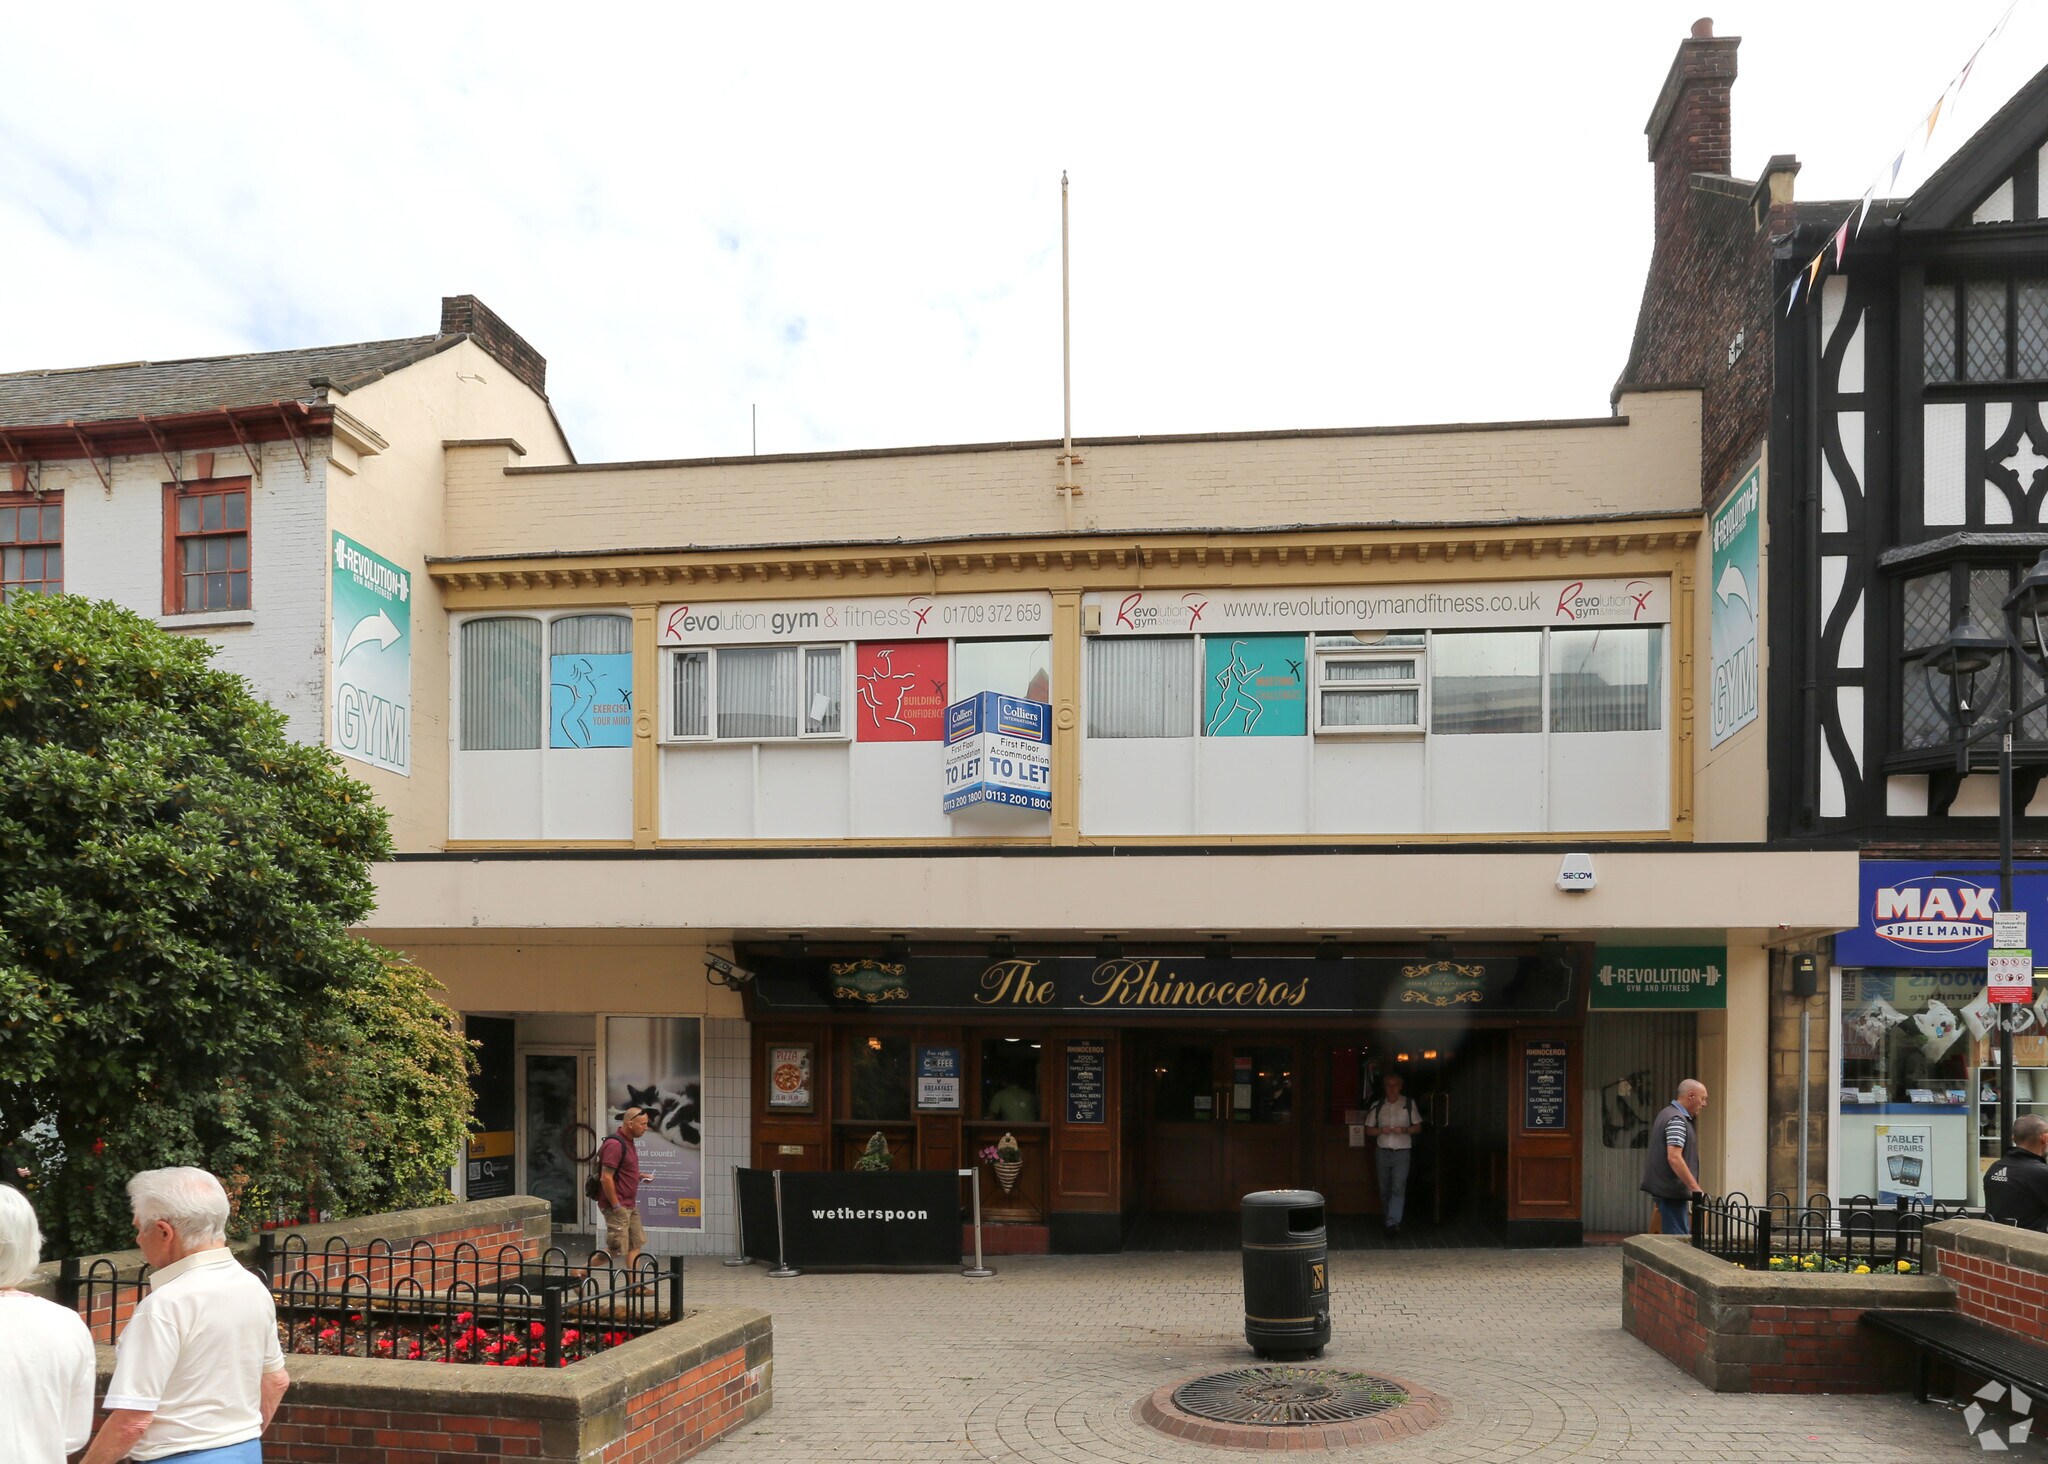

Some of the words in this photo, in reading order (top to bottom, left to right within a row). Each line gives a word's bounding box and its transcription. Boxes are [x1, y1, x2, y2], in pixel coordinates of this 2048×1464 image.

[1720, 487, 1750, 544] REVOLUTION
[347, 547, 398, 595] REVOLUTION
[353, 573, 363, 586] GYM
[374, 584, 393, 601] FITNESS
[1223, 591, 1541, 619] www.revolutiongymandfitness.co.uk
[1556, 582, 1631, 620] Revolution
[1116, 592, 1188, 630] Revolution
[666, 605, 766, 641] Revolution
[771, 611, 819, 634] gym
[824, 606, 838, 628] &
[844, 605, 911, 627] fitness
[943, 605, 984, 624] 01709
[988, 604, 1012, 623] 372
[1016, 603, 1042, 622] 659
[1714, 637, 1755, 737] GYM
[593, 704, 628, 714] EXERCISE
[904, 696, 941, 706] BUILDING
[593, 716, 611, 726] YOUR
[612, 716, 631, 726] MIND
[904, 708, 944, 719] CONFIDENCE
[952, 708, 973, 723] Colliers
[1003, 704, 1038, 722] Colliers
[1004, 715, 1038, 727] INTERNATIONAL
[337, 682, 405, 767] GYM
[951, 745, 962, 755] First
[963, 740, 975, 750] Floor
[1000, 738, 1018, 749] First
[1020, 742, 1040, 753] Floor
[945, 748, 980, 766] Accommodation
[990, 746, 1050, 765] Accommodation
[945, 766, 958, 785] TO
[961, 757, 980, 780] LET
[989, 757, 1013, 778] TO
[1019, 762, 1050, 784] LET
[956, 794, 967, 807] 200
[968, 790, 982, 802] 1800
[985, 789, 1007, 802] 0113
[1010, 793, 1028, 805] 200
[1030, 797, 1052, 810] 1800
[1563, 872, 1592, 880] SECOM
[1875, 887, 1995, 921] MAX
[1887, 925, 1984, 936] SPIELMANN
[974, 959, 1055, 1004] The
[1079, 959, 1309, 1006] Rhinoceros
[1617, 968, 1700, 984] REVOLUTION
[777, 1051, 798, 1060] PIZZA
[1886, 1135, 1925, 1144] TABLET
[650, 1150, 676, 1158] counts!
[812, 1207, 928, 1222] wetherspoon
